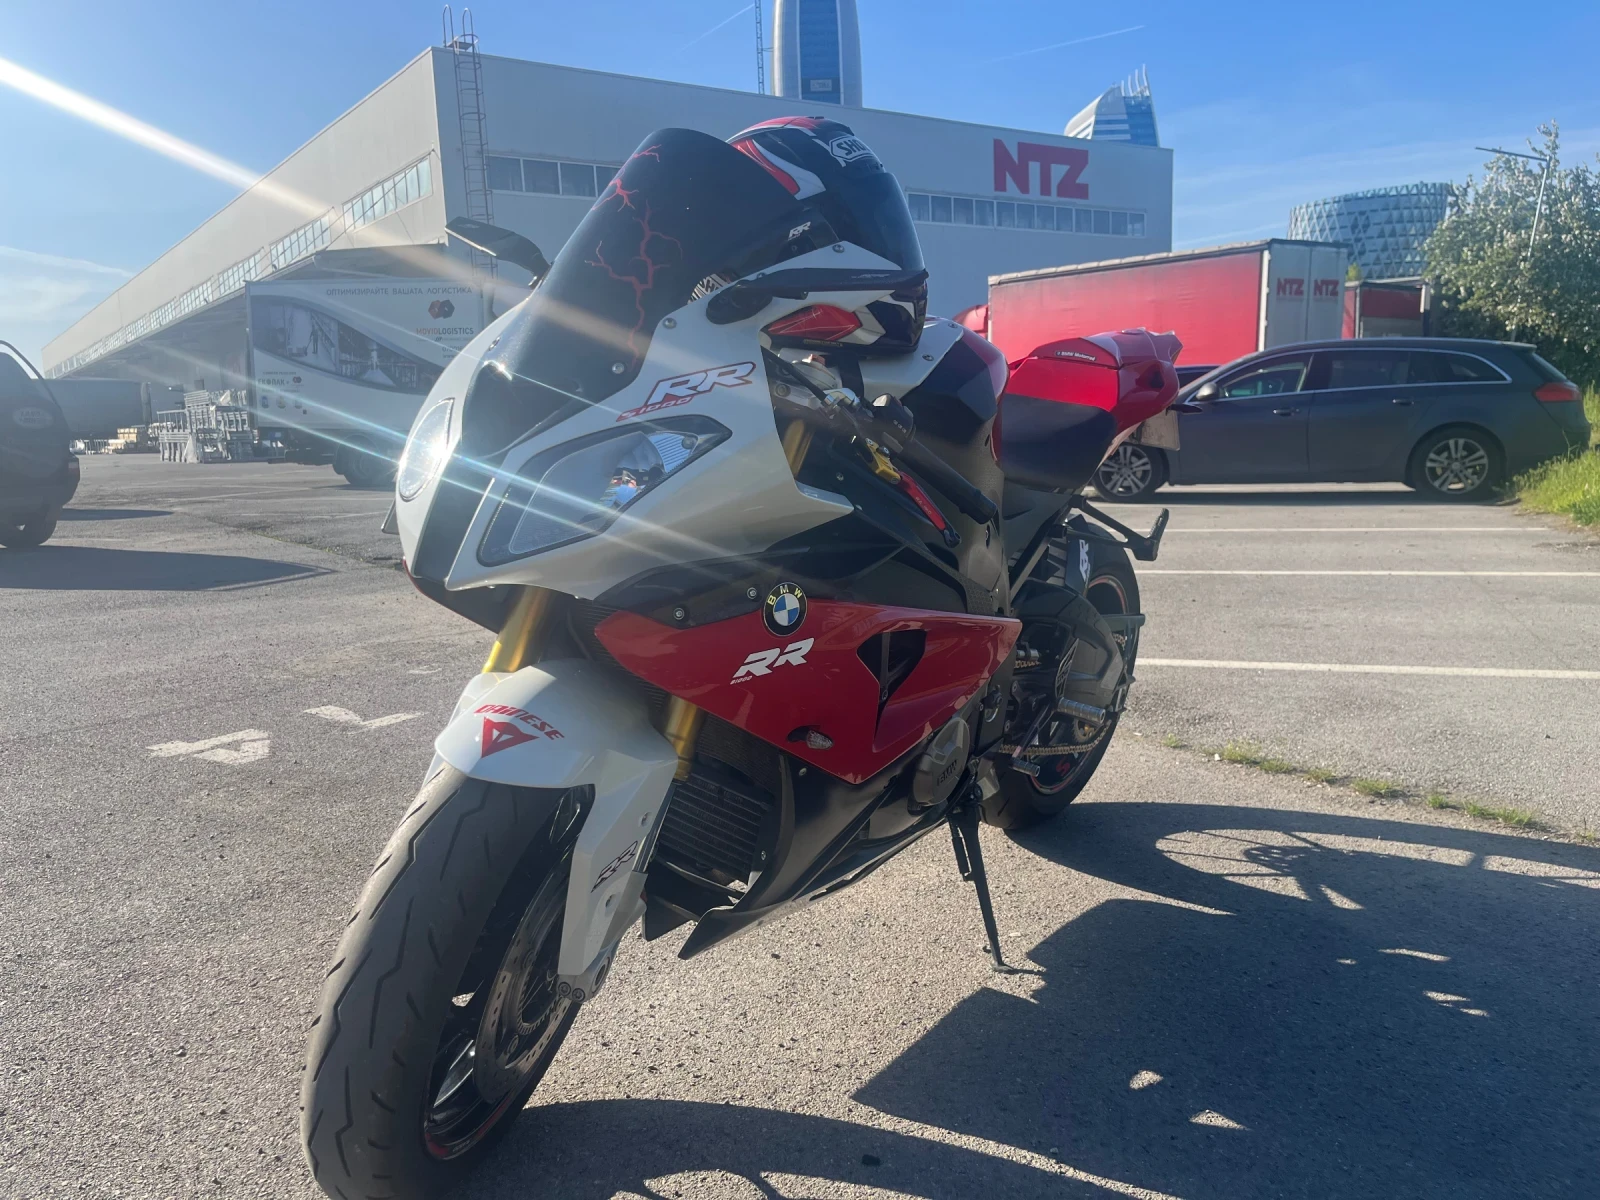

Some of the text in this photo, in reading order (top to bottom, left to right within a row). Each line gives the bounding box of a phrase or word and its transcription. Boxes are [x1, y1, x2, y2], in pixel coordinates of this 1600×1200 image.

[836, 138, 871, 156] SHO
[993, 138, 1089, 200] NTZ
[326, 286, 473, 296] ОПТИМИЗИРАЙТЕ ВАШАТА ЛОГИСТИКА
[1277, 278, 1304, 296] NTZ
[1313, 279, 1339, 297] NTZ
[644, 361, 756, 406] RR
[767, 584, 803, 606] BMW
[732, 637, 815, 678] RR
[473, 704, 565, 740] DAINESE
[590, 840, 638, 893] RR
